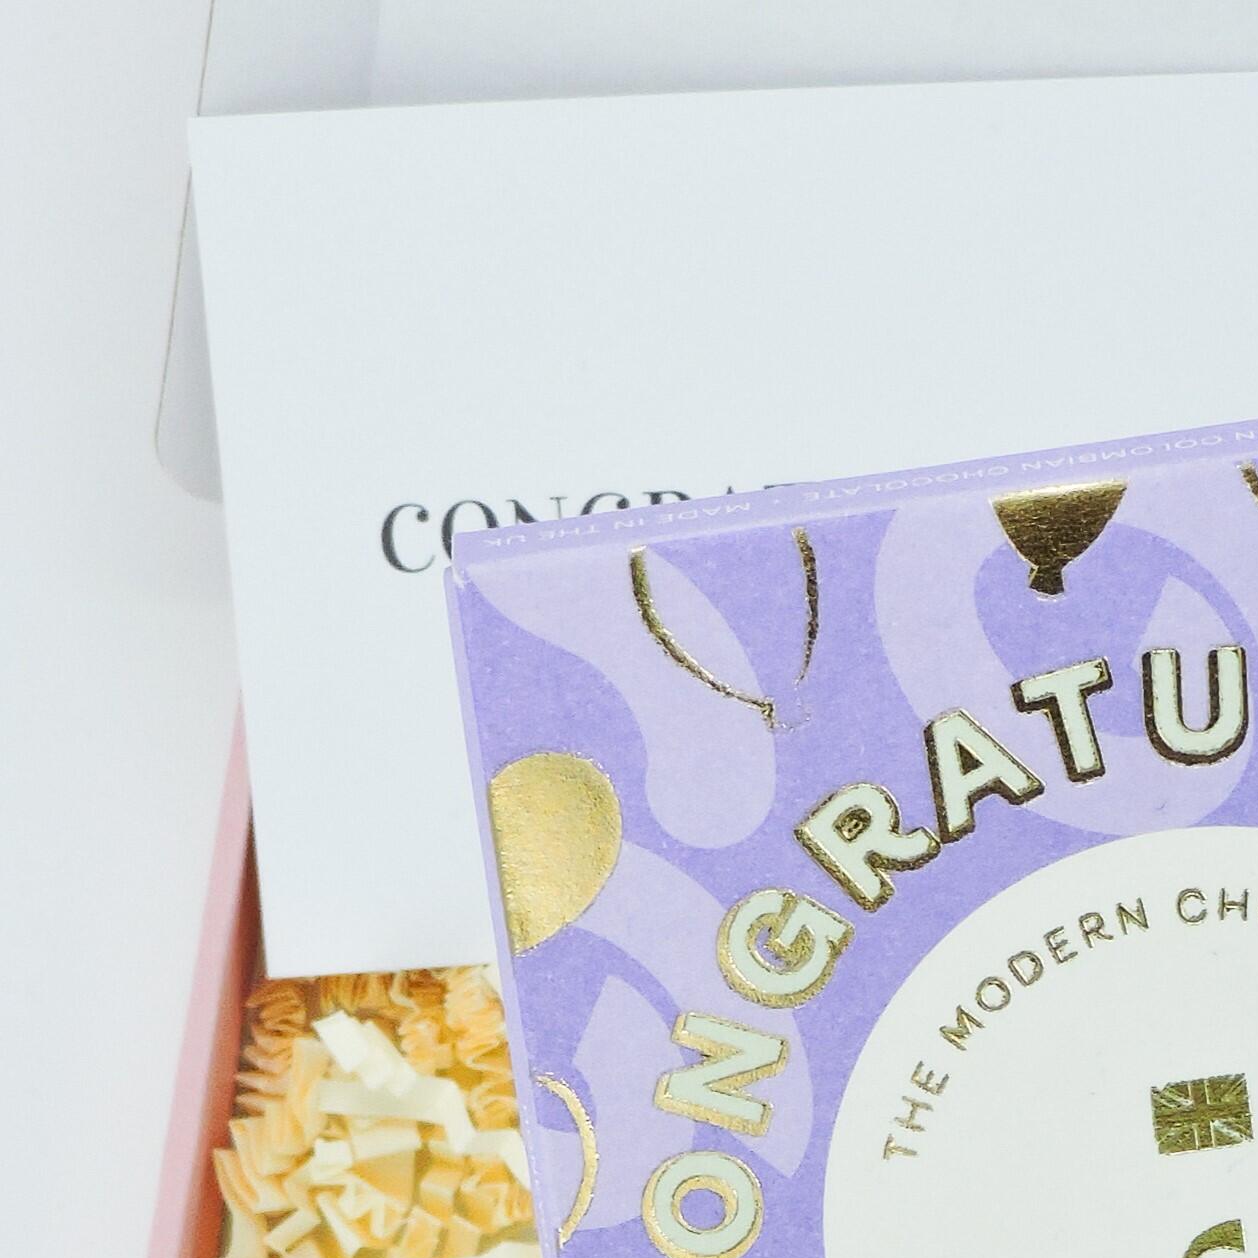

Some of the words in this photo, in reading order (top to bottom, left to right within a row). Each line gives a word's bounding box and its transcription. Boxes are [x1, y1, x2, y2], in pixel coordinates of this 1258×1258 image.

[1021, 435, 1223, 472] COLOMBIAN
[801, 465, 1010, 501] CHOCOLATE
[613, 516, 651, 532] IN
[658, 502, 752, 526] MADE
[482, 535, 532, 550] UK
[537, 526, 601, 541] THE
[881, 1060, 951, 1162] THE
[938, 896, 1150, 1051] MODERN
